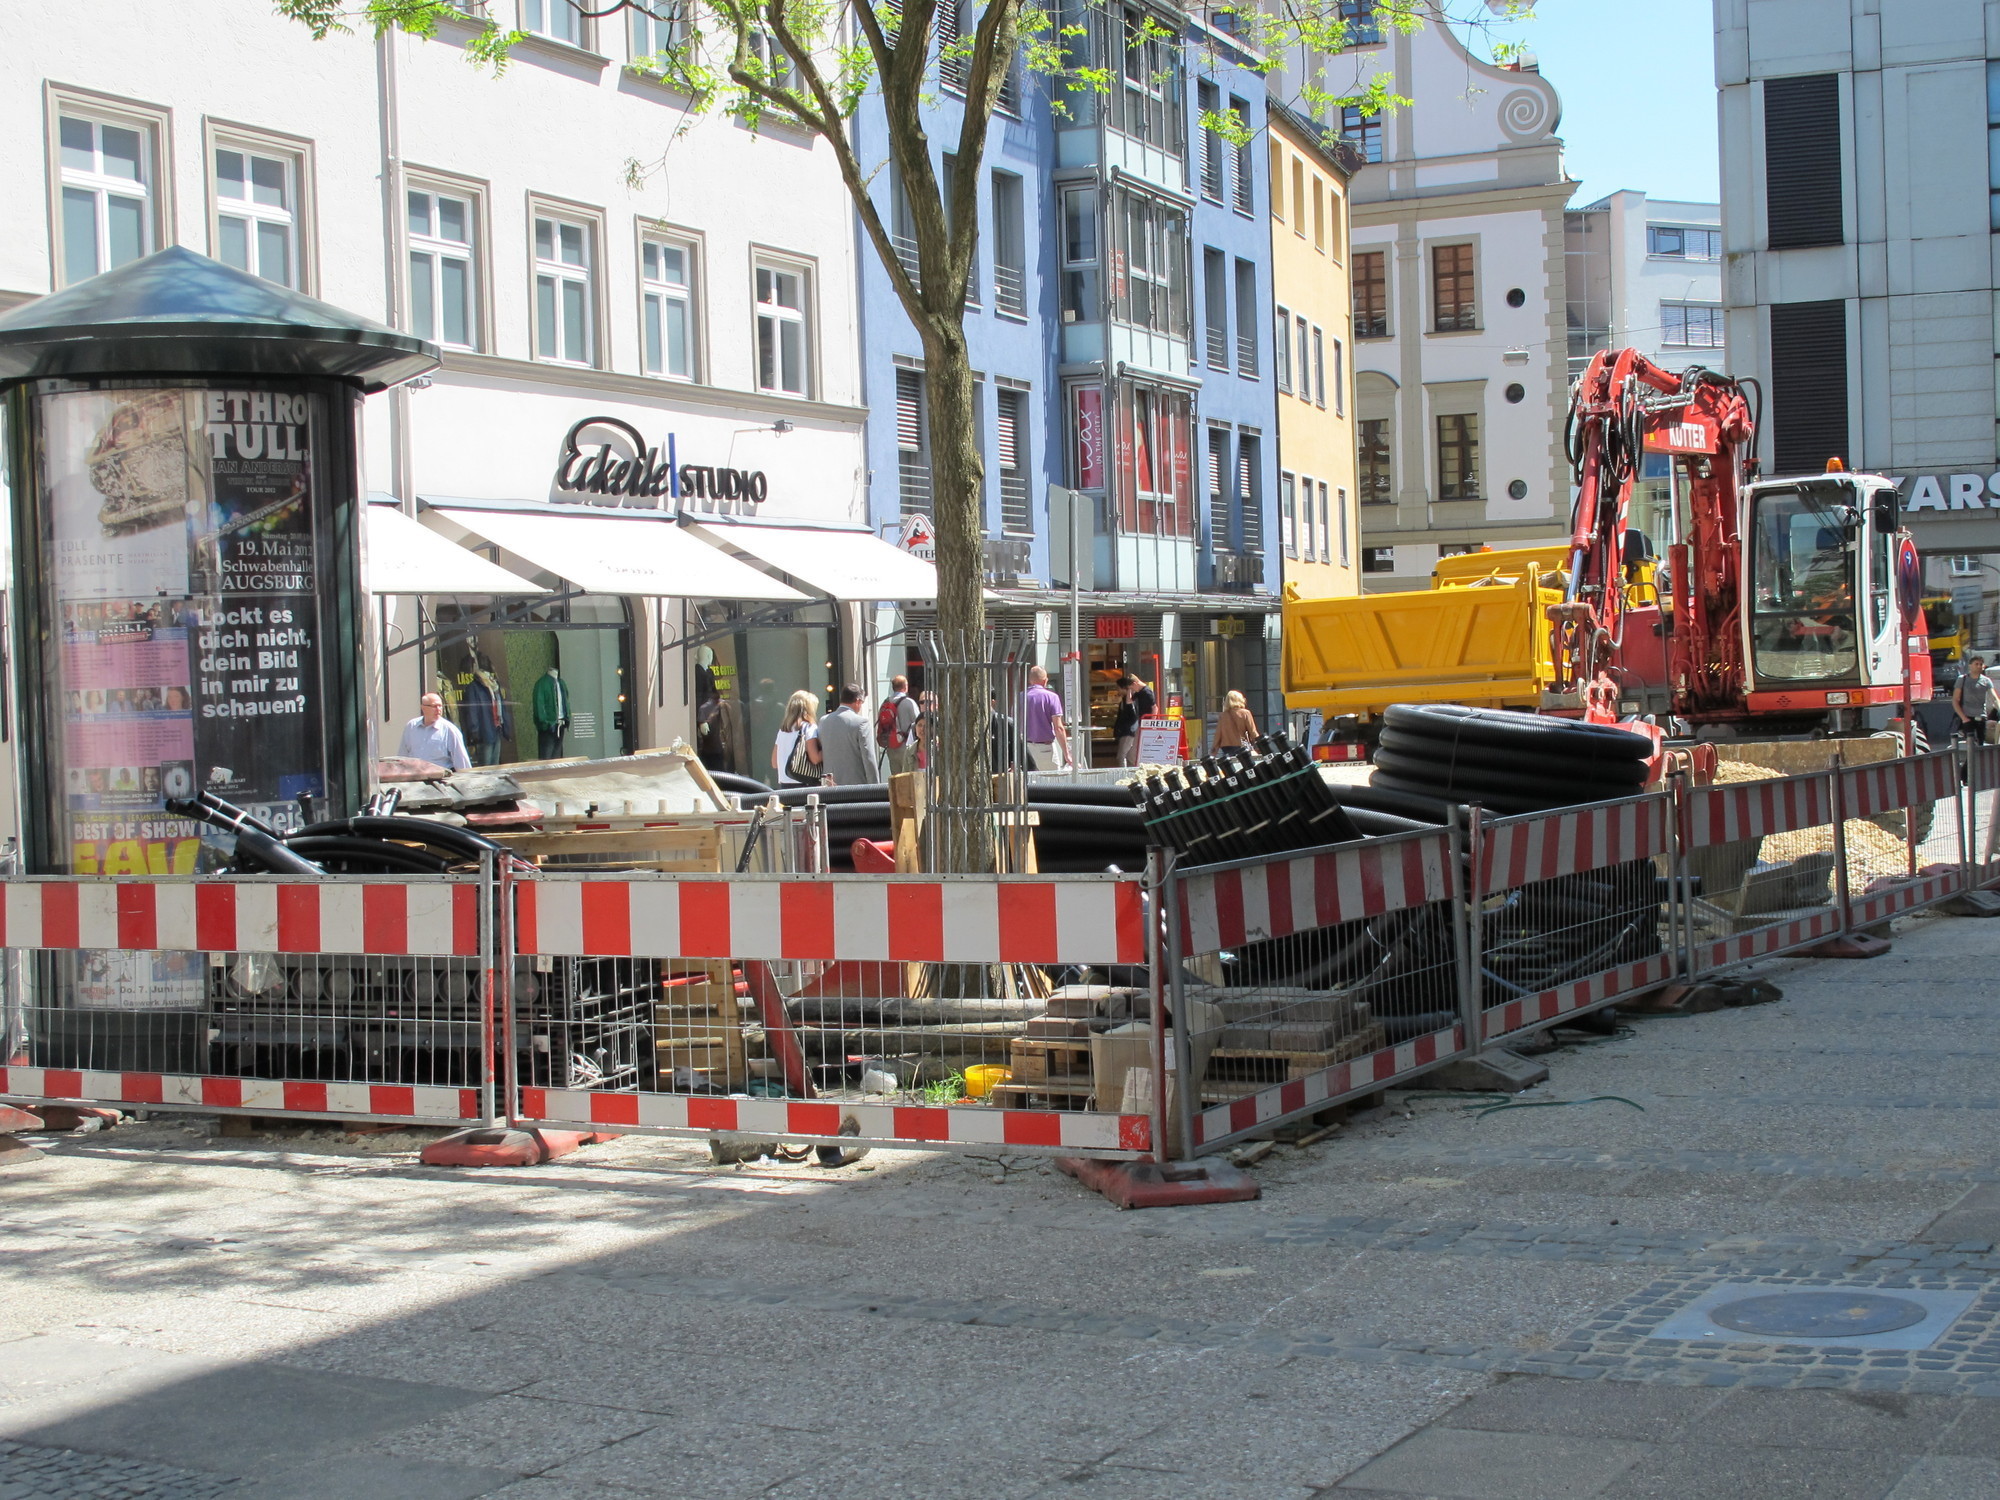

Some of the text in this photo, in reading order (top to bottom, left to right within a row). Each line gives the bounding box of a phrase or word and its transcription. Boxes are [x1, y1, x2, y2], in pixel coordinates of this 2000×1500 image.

[191, 390, 308, 431] JETHRO
[679, 464, 767, 503] STUDIO
[237, 541, 259, 556] 19.
[262, 541, 291, 556] Mai
[222, 560, 313, 572] Schwabenhalle
[222, 575, 314, 590] AUGSBURG
[197, 607, 293, 626] Lockt es
[199, 630, 249, 649] dich
[256, 628, 311, 648] nicht,
[200, 653, 251, 672] dein
[258, 651, 298, 669] Bild
[202, 675, 298, 694] in mir zu
[202, 695, 305, 717] schauen?
[1150, 720, 1179, 728] REITER
[74, 822, 110, 840] BEST
[113, 822, 136, 840] OF
[142, 820, 197, 839] SHOW
[120, 986, 135, 994] Do.
[139, 985, 147, 994] 7.
[151, 985, 174, 993] Juni
